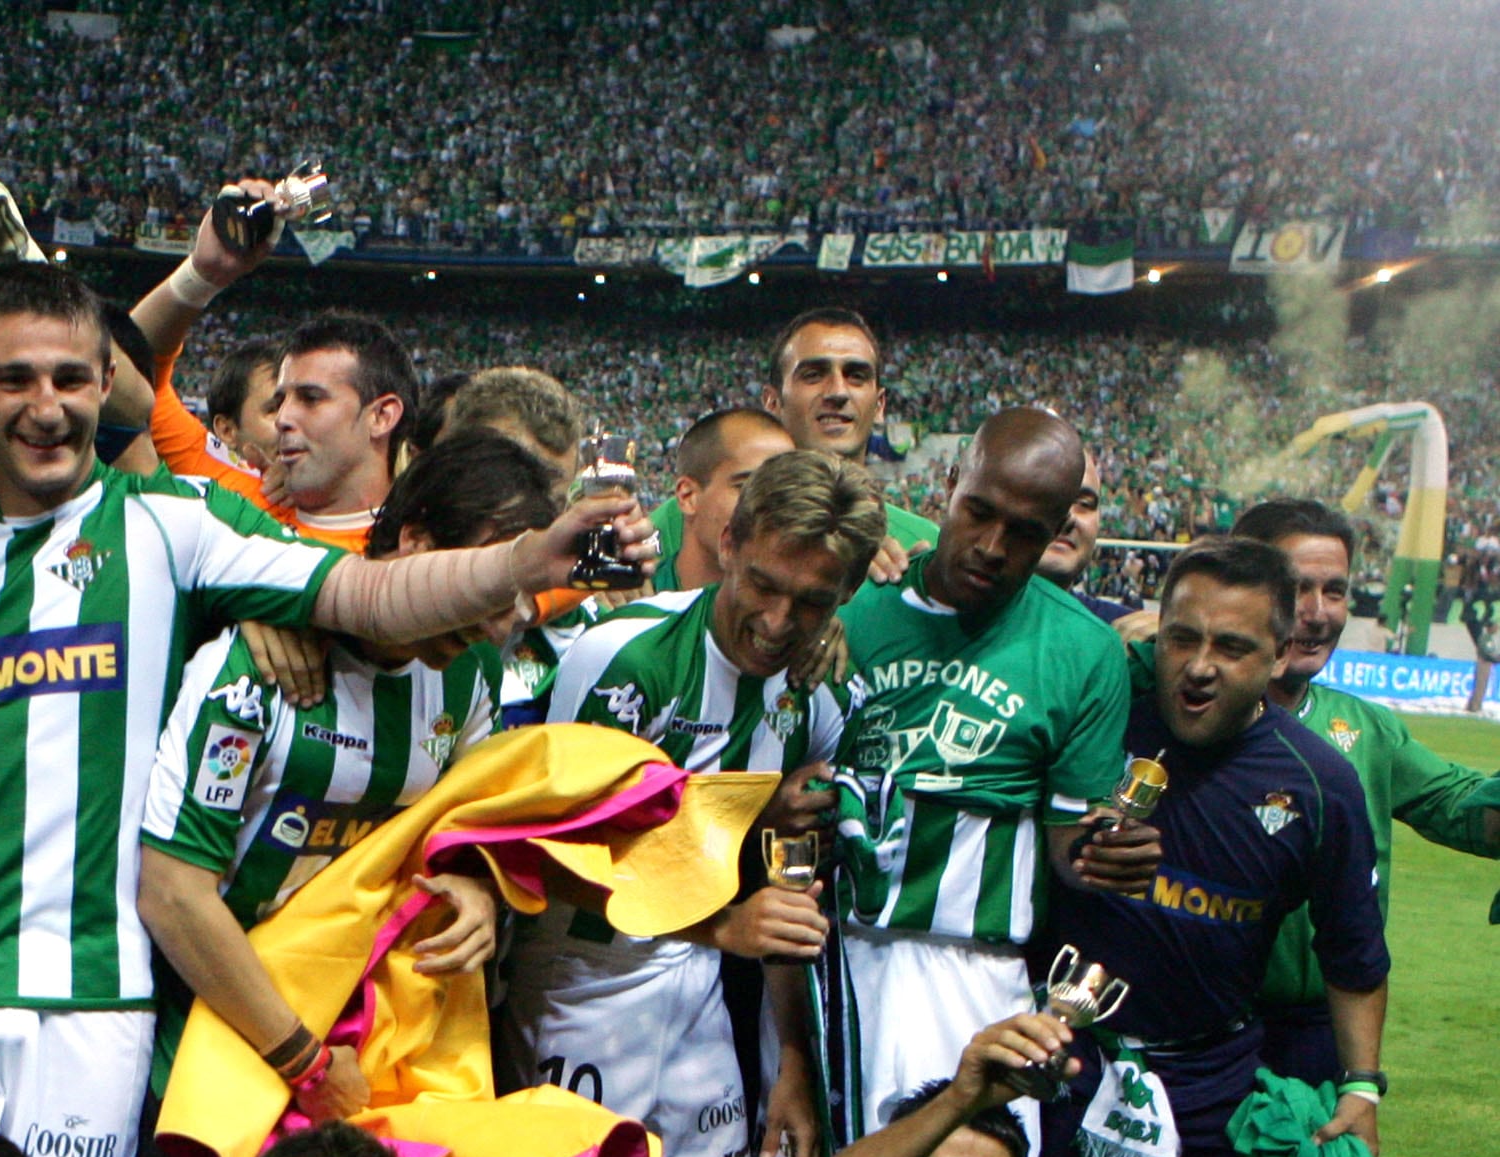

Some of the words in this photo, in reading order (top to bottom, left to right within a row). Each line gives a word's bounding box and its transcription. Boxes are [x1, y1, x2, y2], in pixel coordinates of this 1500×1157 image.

[1342, 660, 1388, 689] BETIS
[303, 723, 368, 752] Kappa
[671, 718, 724, 737] Kappa
[205, 786, 234, 803] LFP
[307, 818, 338, 847] EL
[1152, 875, 1265, 923] MONTE
